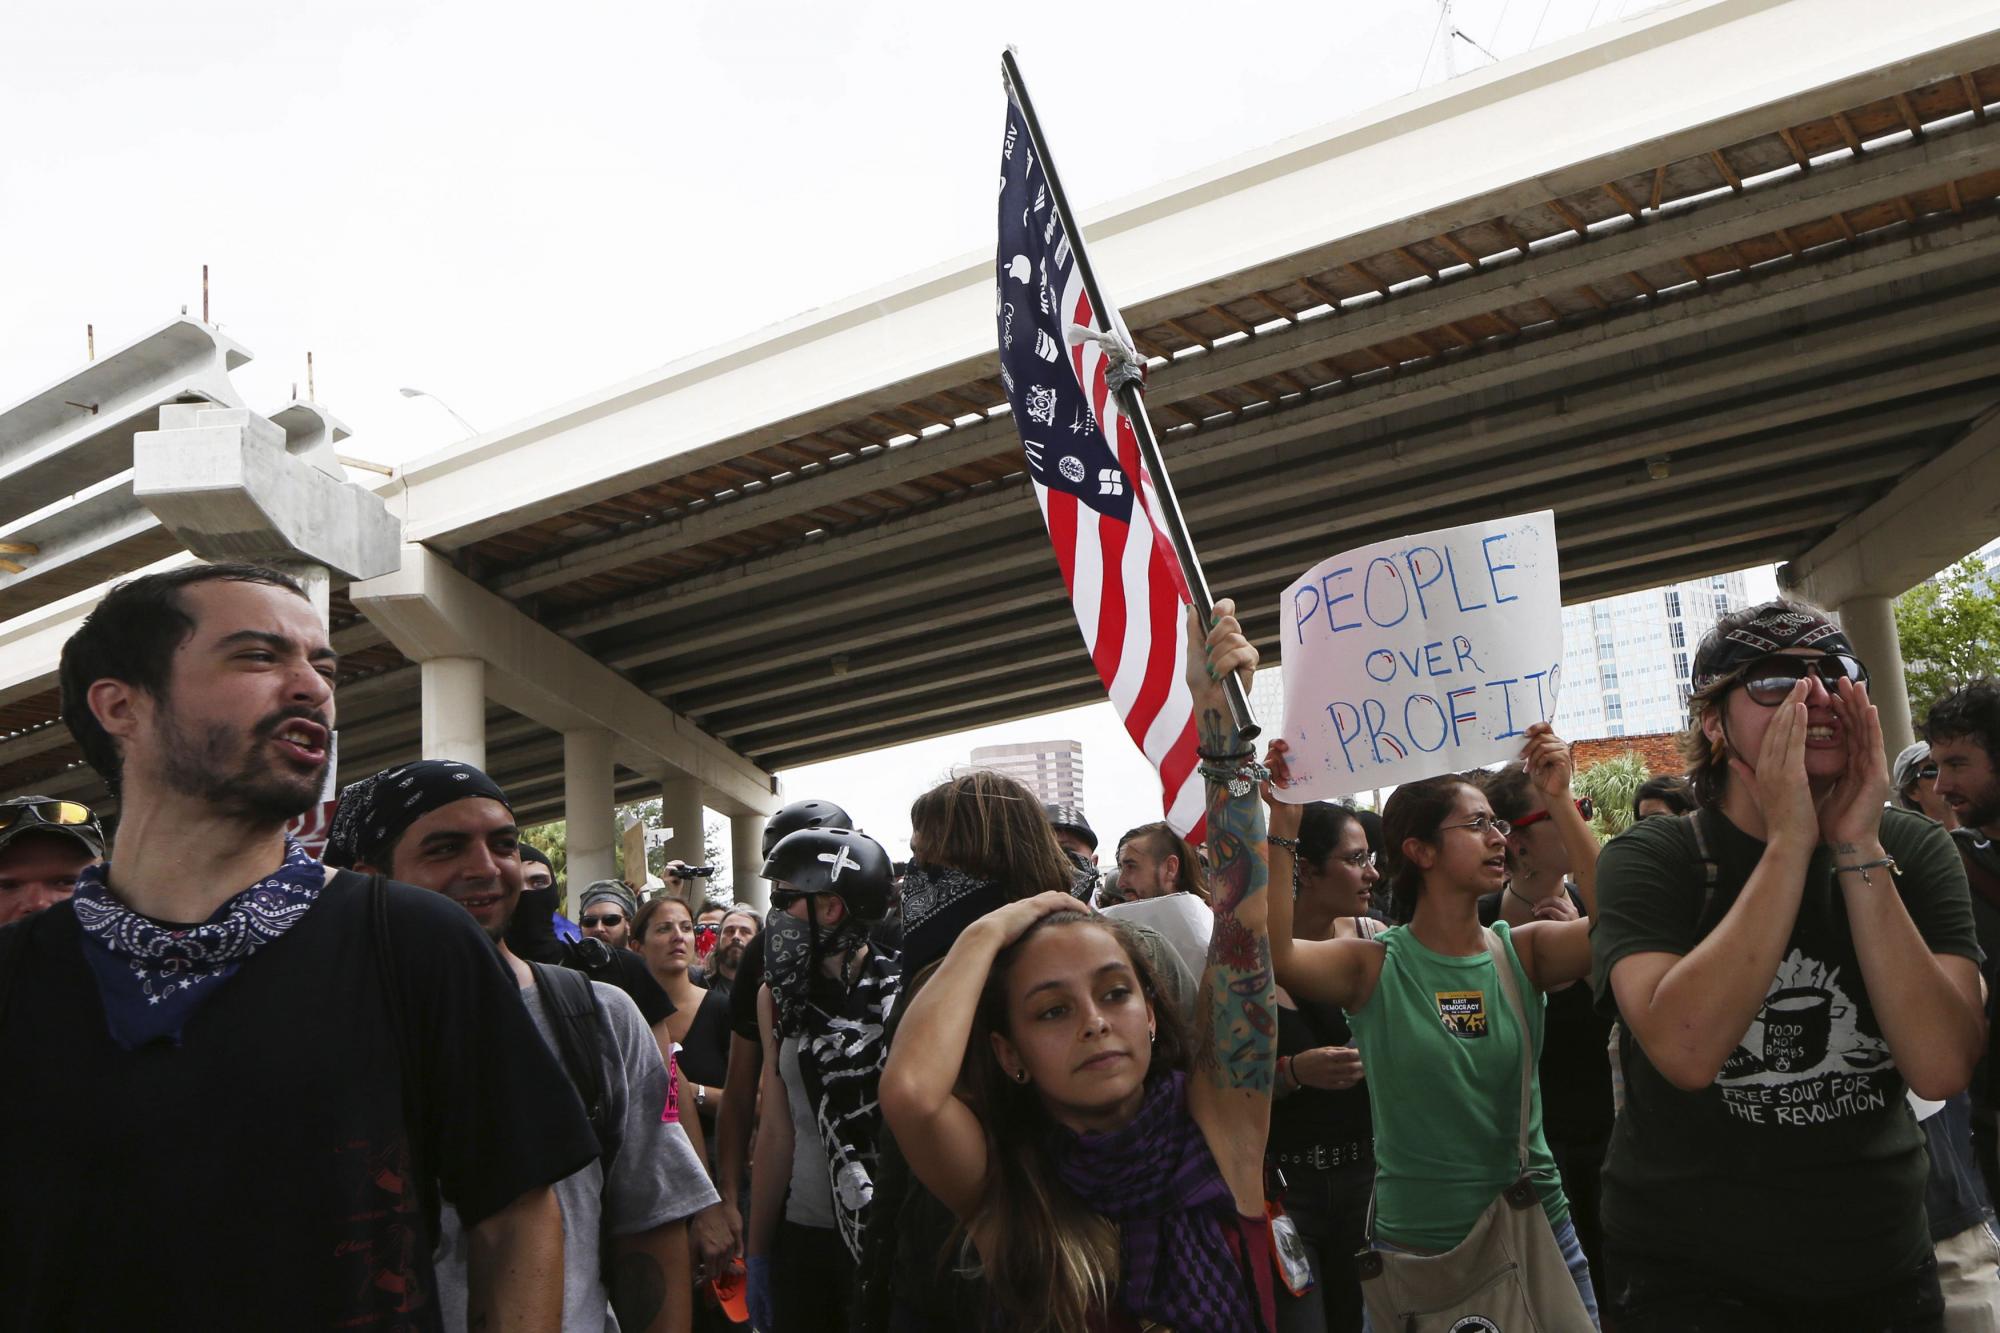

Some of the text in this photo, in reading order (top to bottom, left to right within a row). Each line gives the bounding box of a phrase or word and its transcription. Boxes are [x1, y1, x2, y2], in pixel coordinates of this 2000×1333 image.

[1294, 533, 1519, 645] PEOPLE
[1365, 635, 1485, 682] OVER
[1769, 1024, 1802, 1037] FOOD
[1772, 1036, 1794, 1047] NOT
[1766, 1044, 1804, 1059] BOMBS
[1722, 1075, 1871, 1104] FREE SOUP FOR
[1722, 1089, 1885, 1126] THE REVOLUTION
